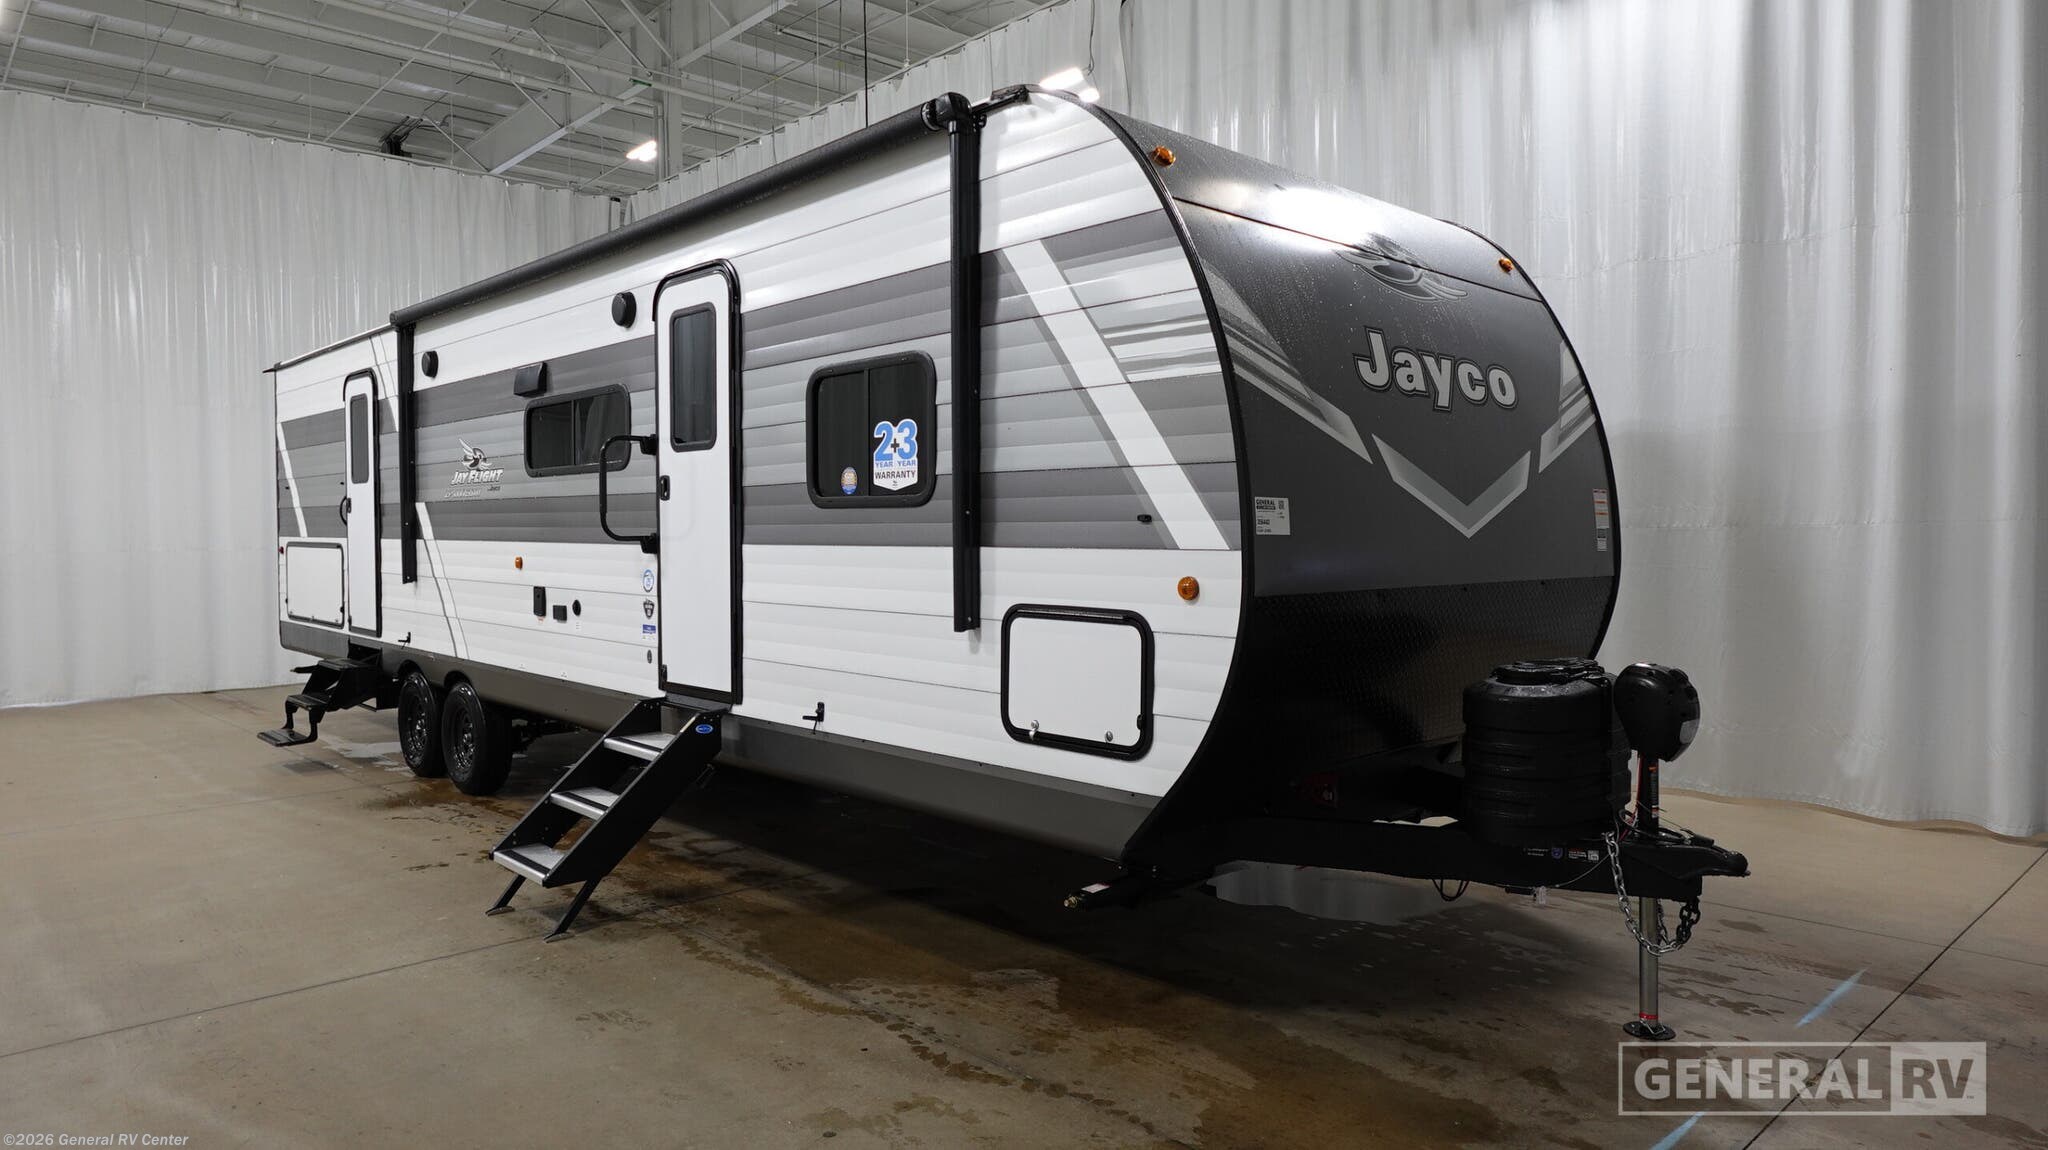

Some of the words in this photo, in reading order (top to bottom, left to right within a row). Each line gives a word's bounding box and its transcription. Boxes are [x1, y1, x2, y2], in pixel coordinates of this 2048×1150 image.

[1353, 325, 1519, 412] Jayco
[450, 471, 469, 485] JAY
[468, 469, 504, 483] FLIGHT
[875, 470, 917, 480] WARRANTY
